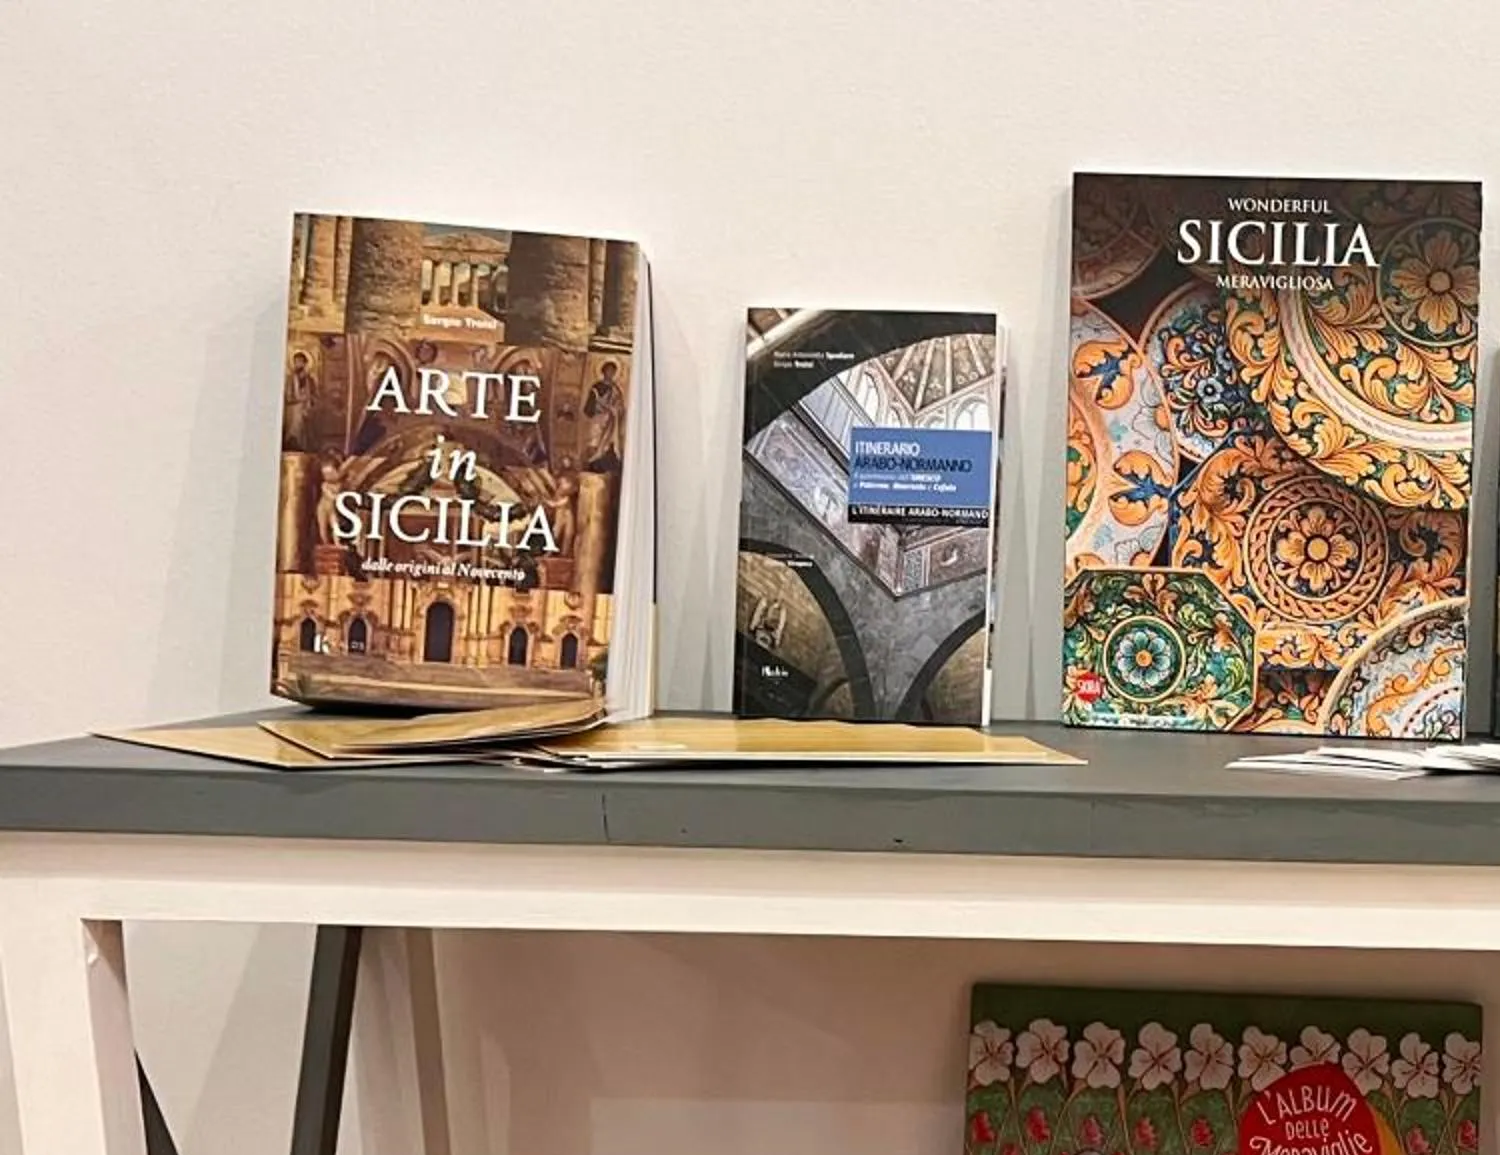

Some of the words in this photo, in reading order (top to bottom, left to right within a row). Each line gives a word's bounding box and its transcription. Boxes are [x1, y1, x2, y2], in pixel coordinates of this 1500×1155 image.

[1228, 197, 1332, 214] WONDERFUL
[1177, 219, 1383, 268] SICILIA
[1216, 275, 1334, 291] MERAVIGLIOSA
[366, 366, 542, 424] ARTE
[426, 435, 477, 482] in
[855, 441, 920, 457] ITINERARIO
[855, 456, 973, 473] ARABO-NORMANNO
[334, 491, 559, 552] SICILIA
[361, 557, 393, 572] dalle
[395, 559, 440, 577] origini
[458, 562, 526, 581] Novecento
[1256, 1085, 1357, 1125] L'ALBUM
